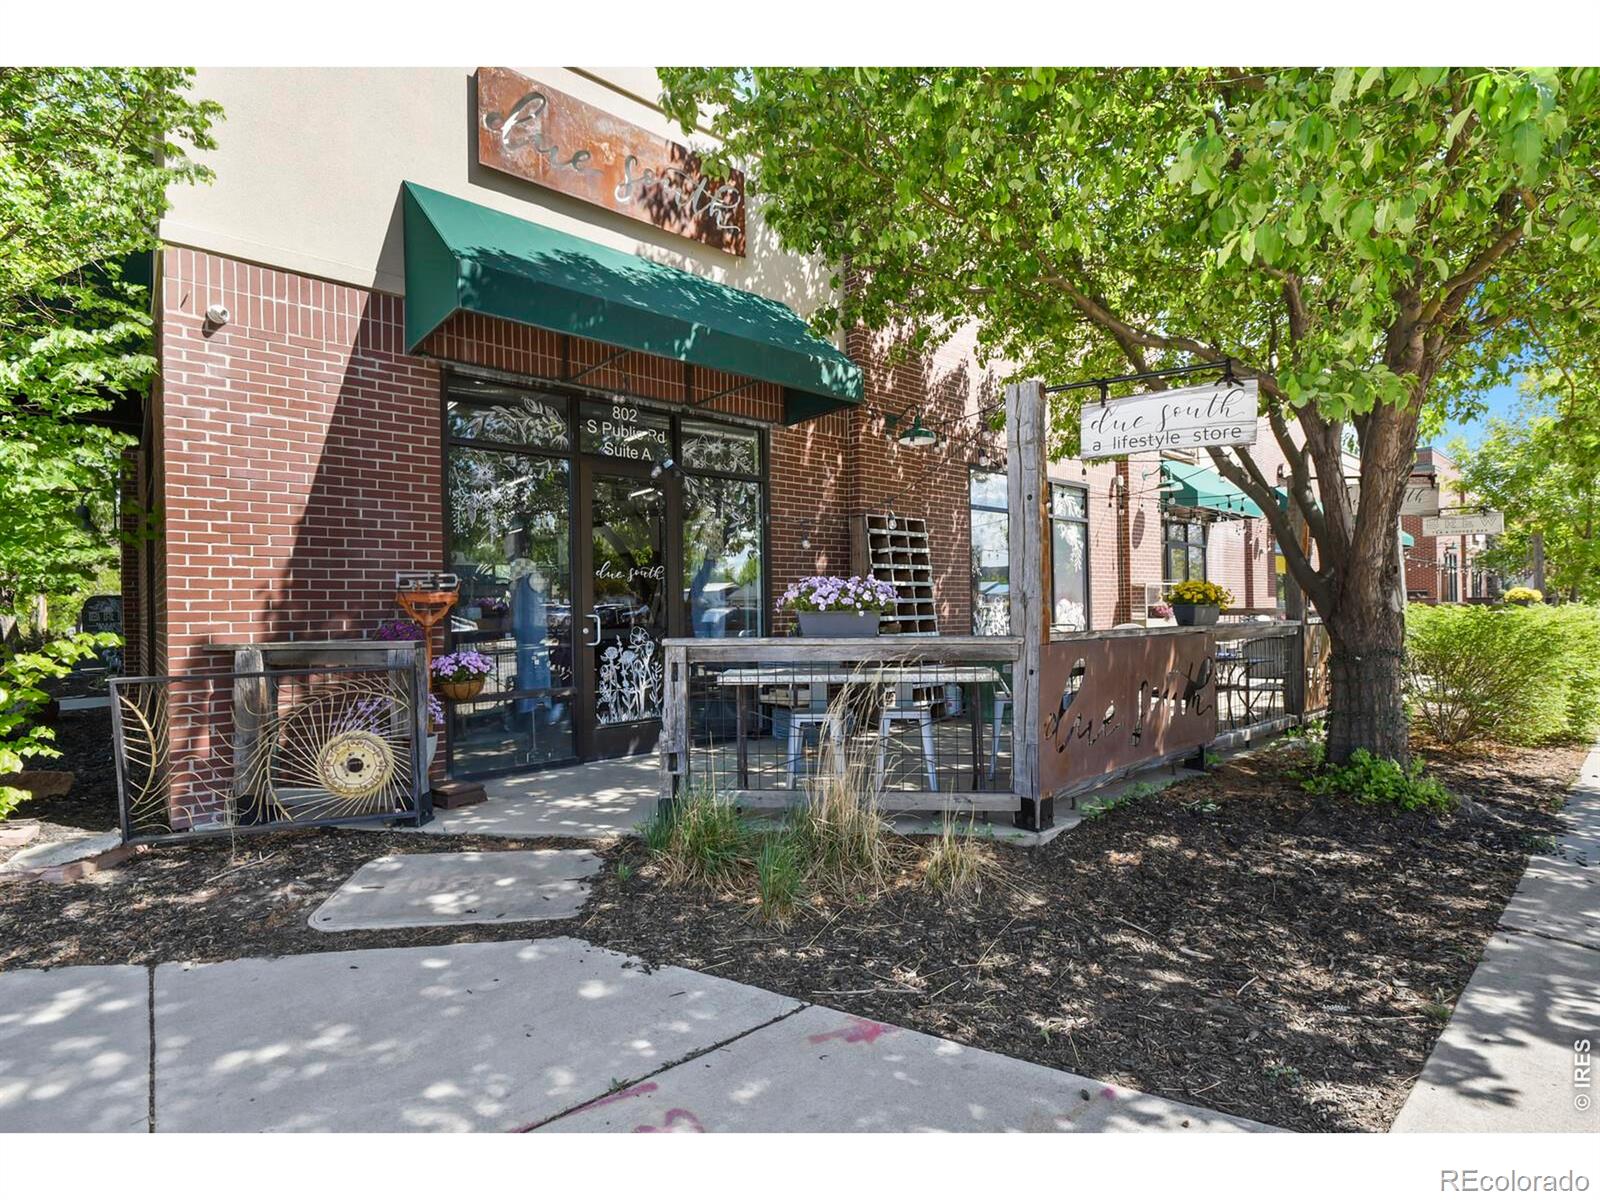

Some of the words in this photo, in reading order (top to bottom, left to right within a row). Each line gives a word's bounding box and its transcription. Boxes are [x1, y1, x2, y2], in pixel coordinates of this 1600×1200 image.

[612, 406, 638, 423] 802
[1090, 403, 1149, 434] due
[1157, 388, 1246, 433] south
[587, 419, 598, 434] S
[602, 421, 644, 441] Public
[648, 429, 666, 444] Rd
[1092, 440, 1101, 452] a
[1112, 431, 1181, 450] lifestyle
[1193, 426, 1242, 443] store
[604, 441, 639, 460] Suite
[641, 447, 652, 461] A
[595, 560, 626, 580] due
[626, 565, 665, 582] south
